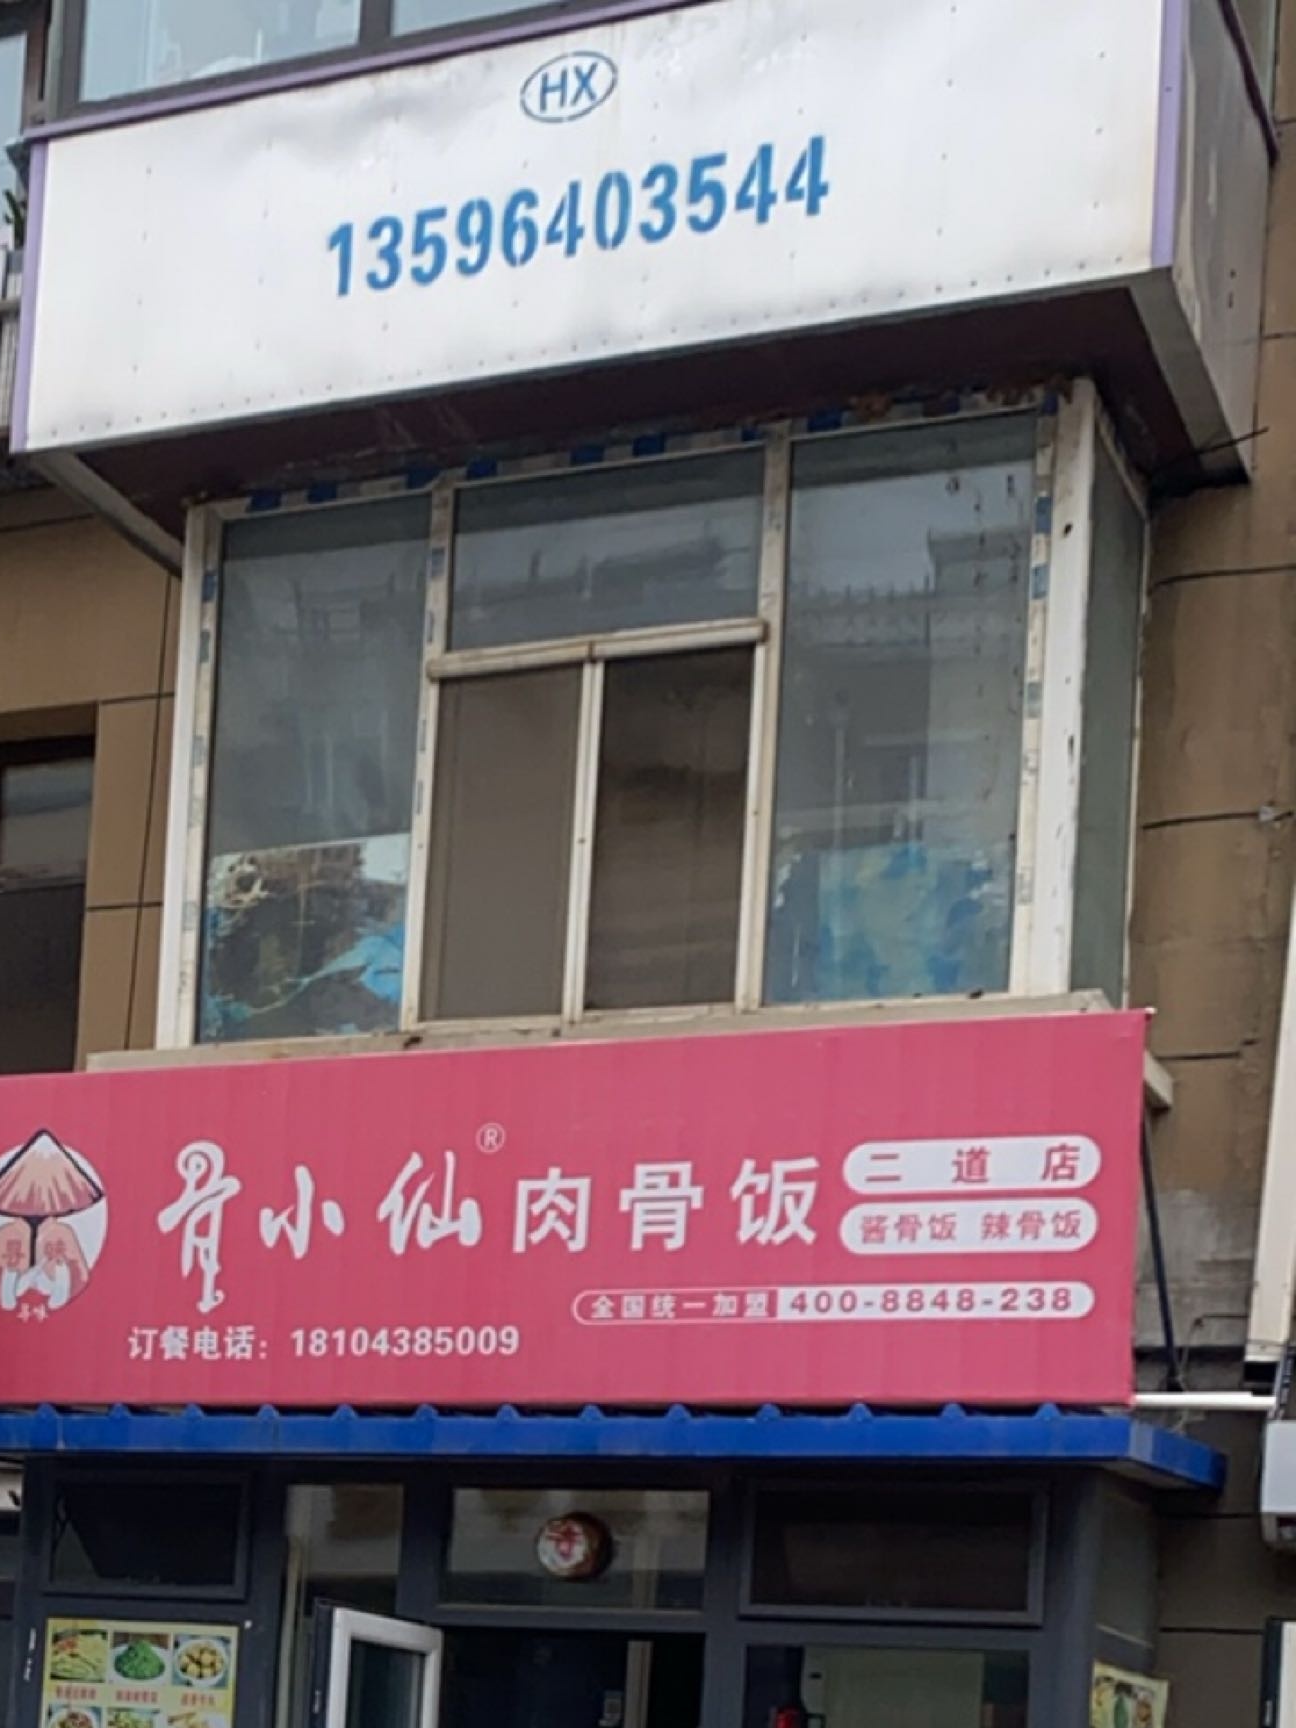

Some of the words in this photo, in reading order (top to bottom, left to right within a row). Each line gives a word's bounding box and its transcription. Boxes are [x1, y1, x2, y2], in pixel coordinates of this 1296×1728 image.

[539, 63, 598, 112] HX
[327, 135, 829, 297] 13596403544
[789, 1287, 1072, 1313] 400-8848-238
